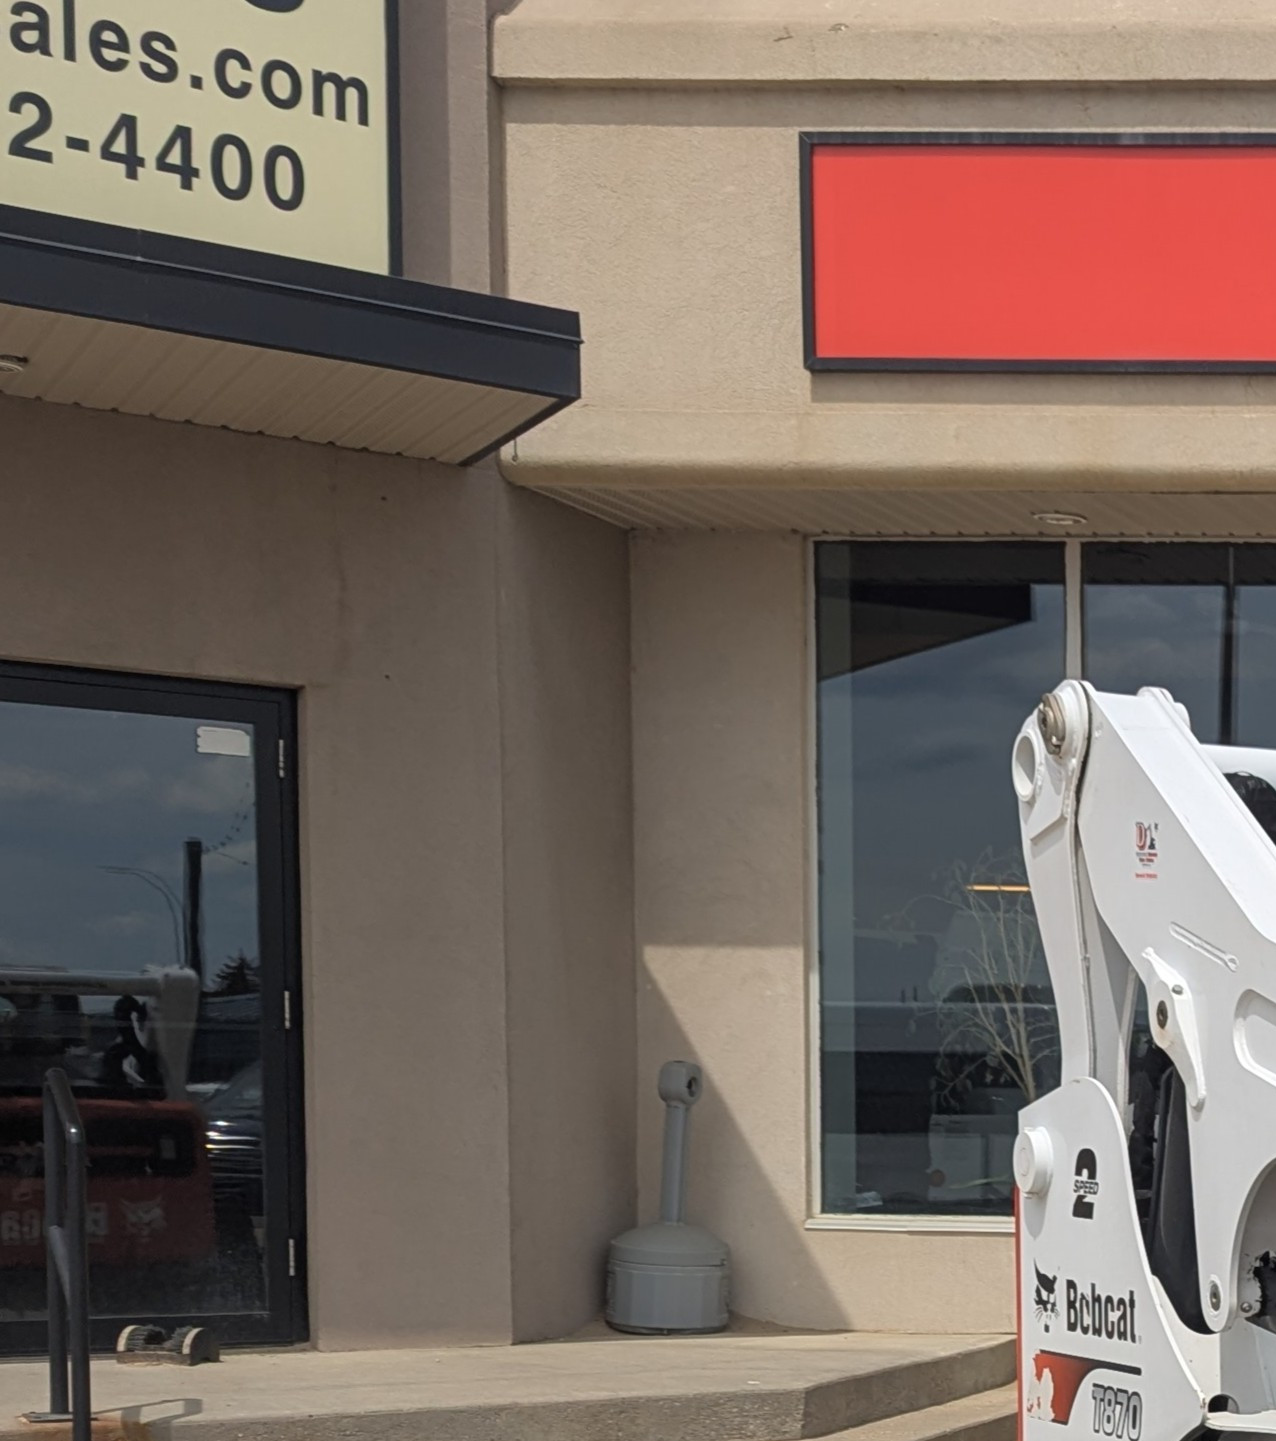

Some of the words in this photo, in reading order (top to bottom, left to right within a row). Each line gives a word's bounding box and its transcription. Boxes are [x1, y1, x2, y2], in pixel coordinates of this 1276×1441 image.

[9, 0, 370, 127] ales.com
[7, 91, 306, 211] 2-4400
[1072, 1148, 1097, 1219] 2
[1073, 1179, 1099, 1195] SPEED
[1066, 1278, 1137, 1344] Bobcat
